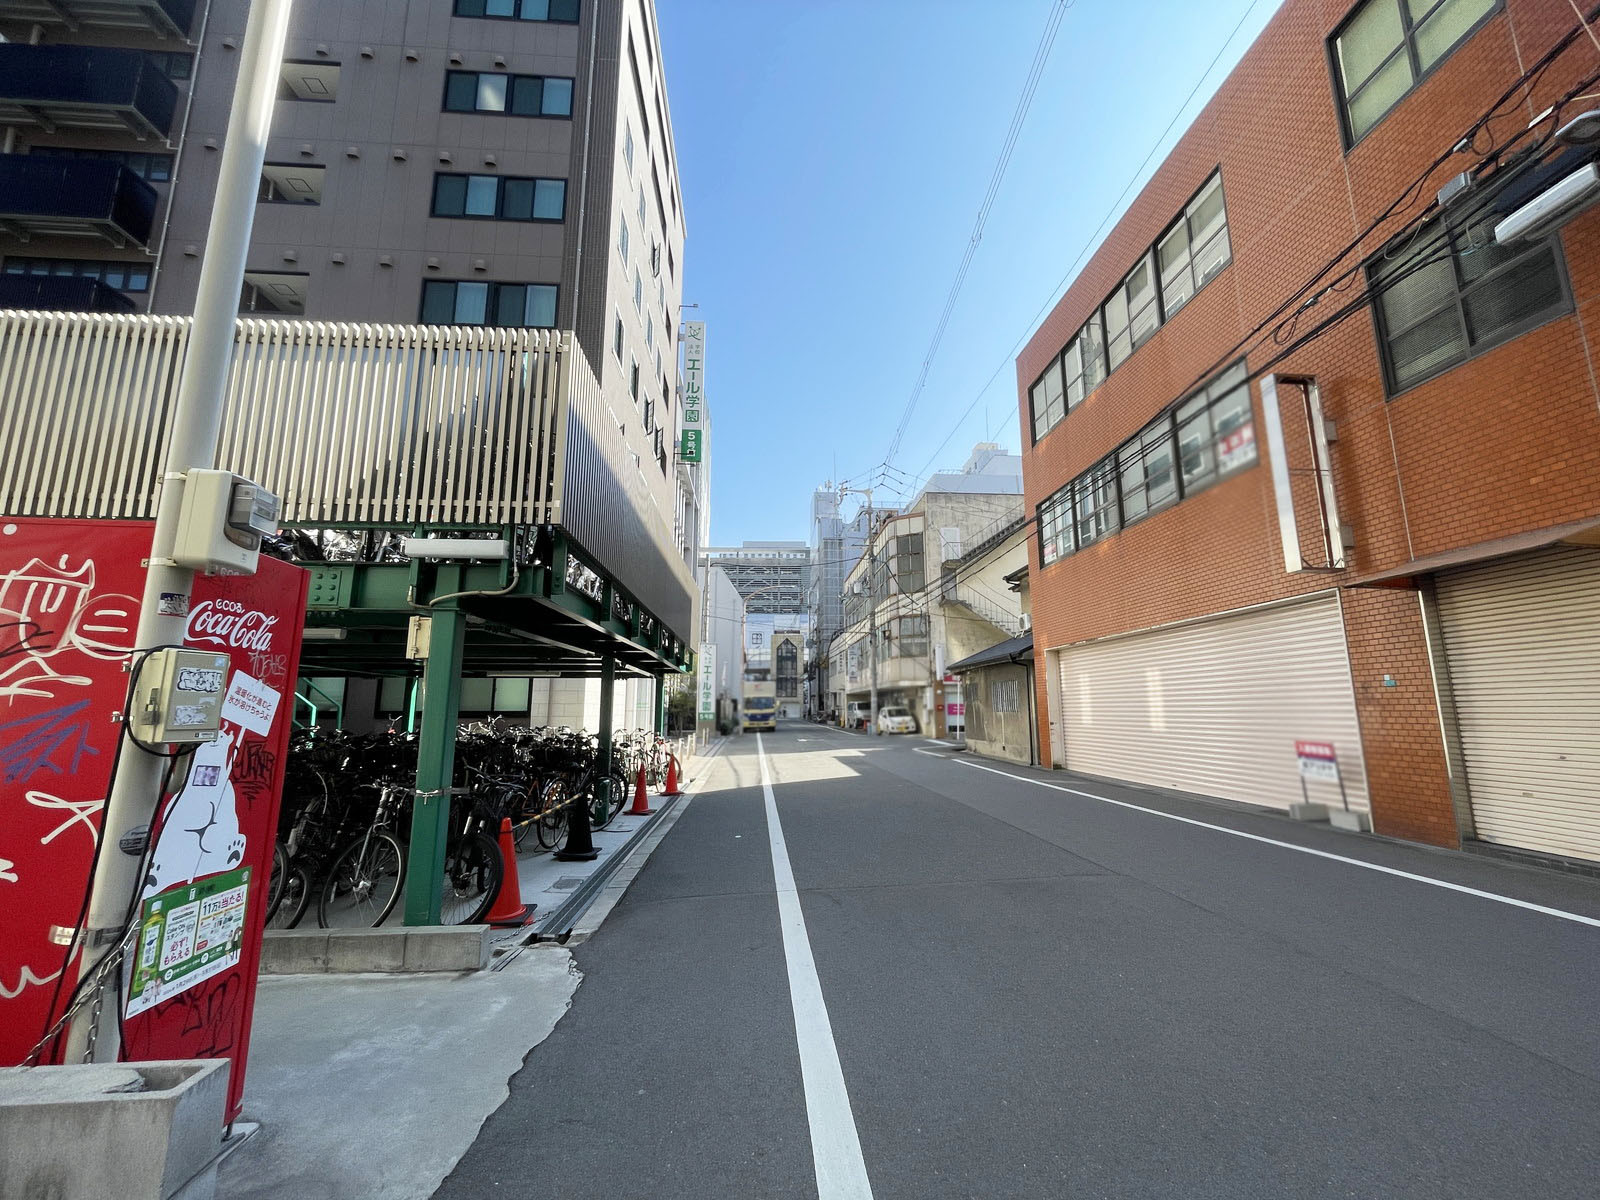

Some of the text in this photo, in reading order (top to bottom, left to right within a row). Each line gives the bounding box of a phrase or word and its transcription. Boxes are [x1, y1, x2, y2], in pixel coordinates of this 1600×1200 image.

[685, 358, 701, 422] エール学園
[184, 600, 280, 651] Coca-Cola
[163, 946, 190, 965] もらえる
